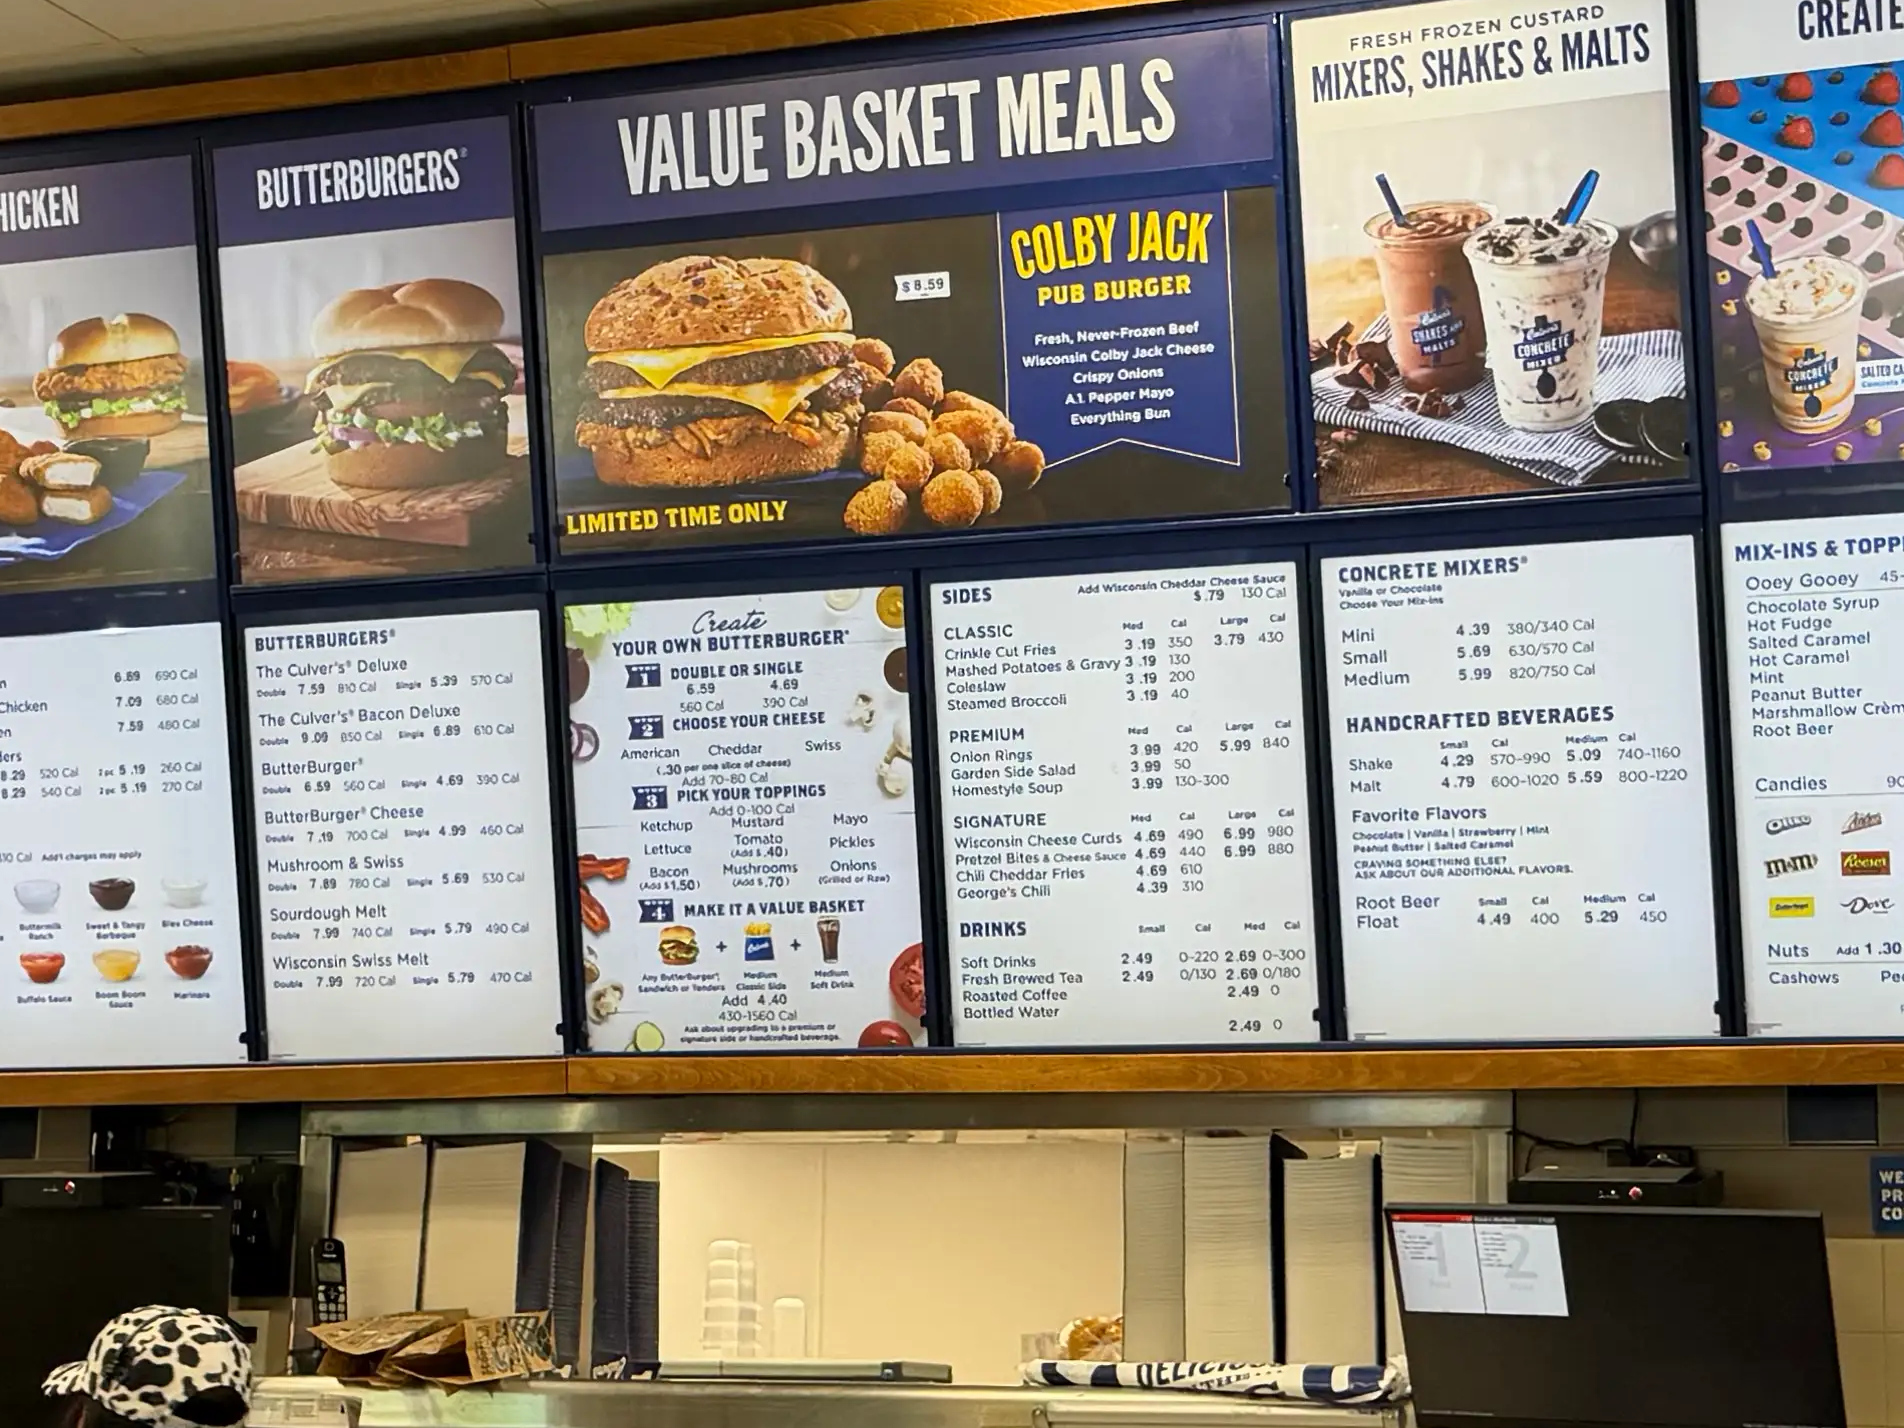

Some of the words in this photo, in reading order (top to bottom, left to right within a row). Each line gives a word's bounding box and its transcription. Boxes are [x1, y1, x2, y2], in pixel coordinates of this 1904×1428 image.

[1350, 31, 1411, 51] FRESH
[1421, 19, 1500, 41] FROZEN
[1511, 5, 1604, 29] CUSTARD
[1312, 55, 1413, 103] MIXERS,
[1422, 40, 1523, 88] SHAKES
[1534, 36, 1553, 75] &
[1562, 23, 1649, 71] MALTS
[618, 104, 768, 194] VALUE
[784, 80, 980, 179] BASKET
[996, 59, 1175, 157] MEALS
[1011, 213, 1116, 279] COLBY
[1128, 210, 1212, 263] JACK
[1037, 282, 1085, 306] PUB
[1094, 275, 1192, 302] BURGER
[1035, 332, 1074, 345] Fresh,
[1077, 326, 1165, 342] Never-Frozen
[1169, 321, 1199, 334] Beef
[1022, 352, 1087, 367] Wisconsin
[1091, 349, 1129, 361] Colby
[1132, 345, 1163, 358] Jack
[1167, 344, 1214, 355] Cheese
[1073, 372, 1114, 384] Crispy
[1118, 368, 1163, 380] Onions
[1089, 391, 1135, 404] Pepper
[1139, 388, 1174, 400] Mayo
[1071, 410, 1141, 425] Everything
[1145, 408, 1170, 419] Bun
[567, 510, 658, 534] LIMITED
[665, 505, 722, 527] TIME
[729, 501, 787, 523] ONLY
[1735, 542, 1817, 561] MIX-INS
[1824, 540, 1838, 556] &
[944, 624, 1012, 640] CLASSIC
[1347, 712, 1490, 733] HANDCRAFTED
[1498, 706, 1614, 726] BEVERAGES
[954, 813, 1046, 829] SIGNATURE
[960, 922, 1026, 937] DRINKS
[963, 990, 1012, 1004] Roasted
[1022, 988, 1067, 1001] Coffee
[1879, 1171, 1904, 1184] WE
